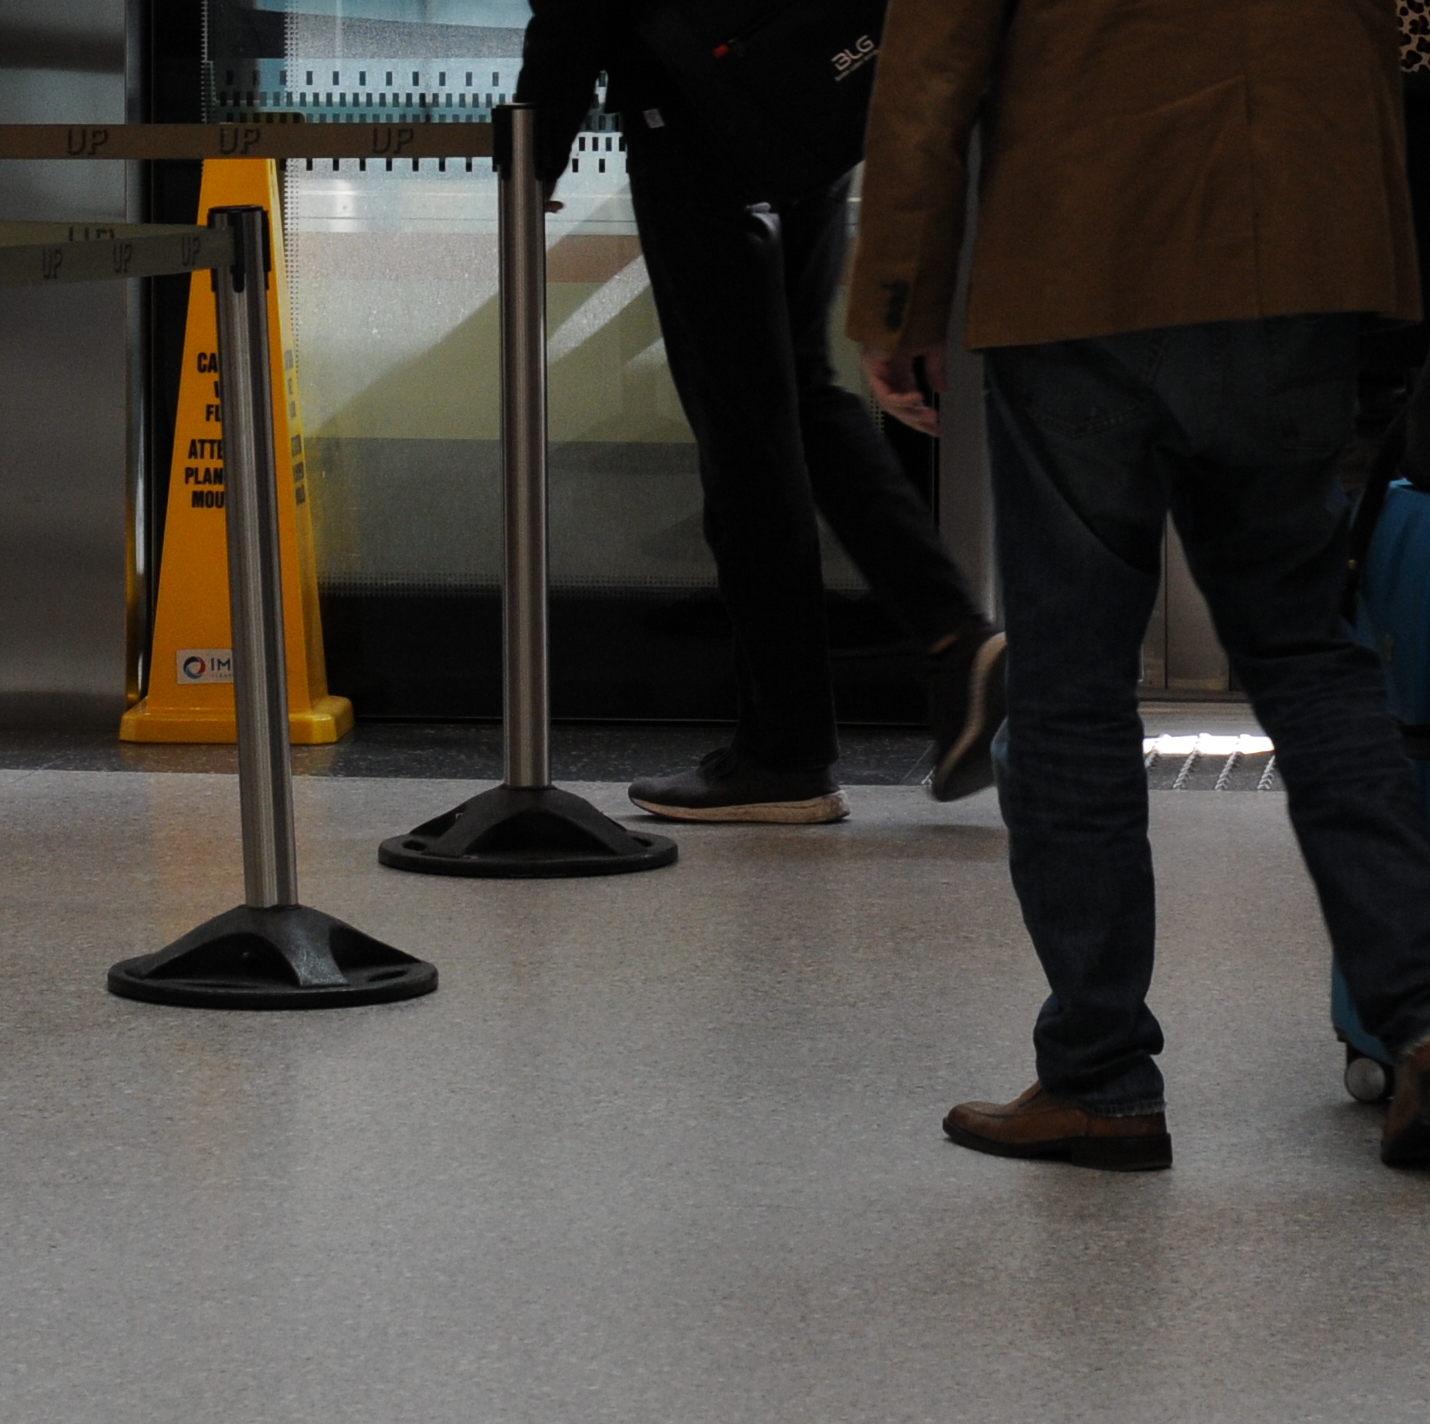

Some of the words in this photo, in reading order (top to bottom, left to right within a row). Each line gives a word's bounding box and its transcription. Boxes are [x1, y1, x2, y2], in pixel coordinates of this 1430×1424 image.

[830, 34, 876, 72] BLG
[66, 128, 110, 156] UP
[218, 127, 261, 155] UP
[371, 127, 415, 155] UP
[42, 246, 63, 281] UP
[112, 243, 133, 274] UP
[181, 236, 202, 267] UP
